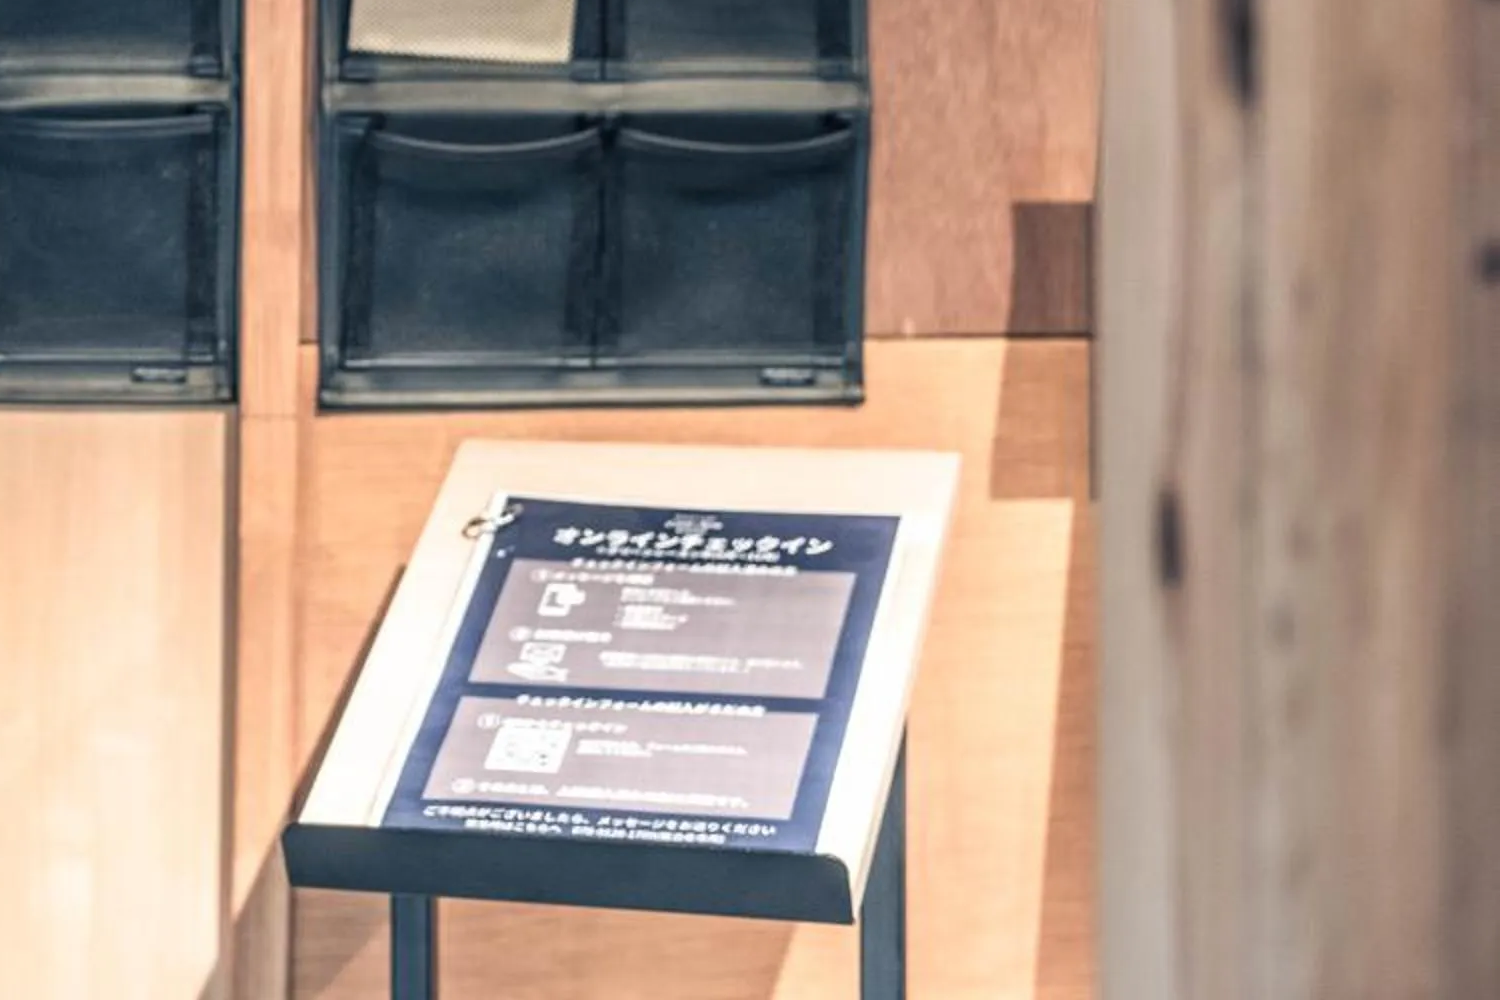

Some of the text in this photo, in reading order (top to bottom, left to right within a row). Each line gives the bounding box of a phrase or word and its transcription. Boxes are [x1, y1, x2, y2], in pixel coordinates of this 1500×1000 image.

[553, 526, 833, 555] オンラインチェックイン
